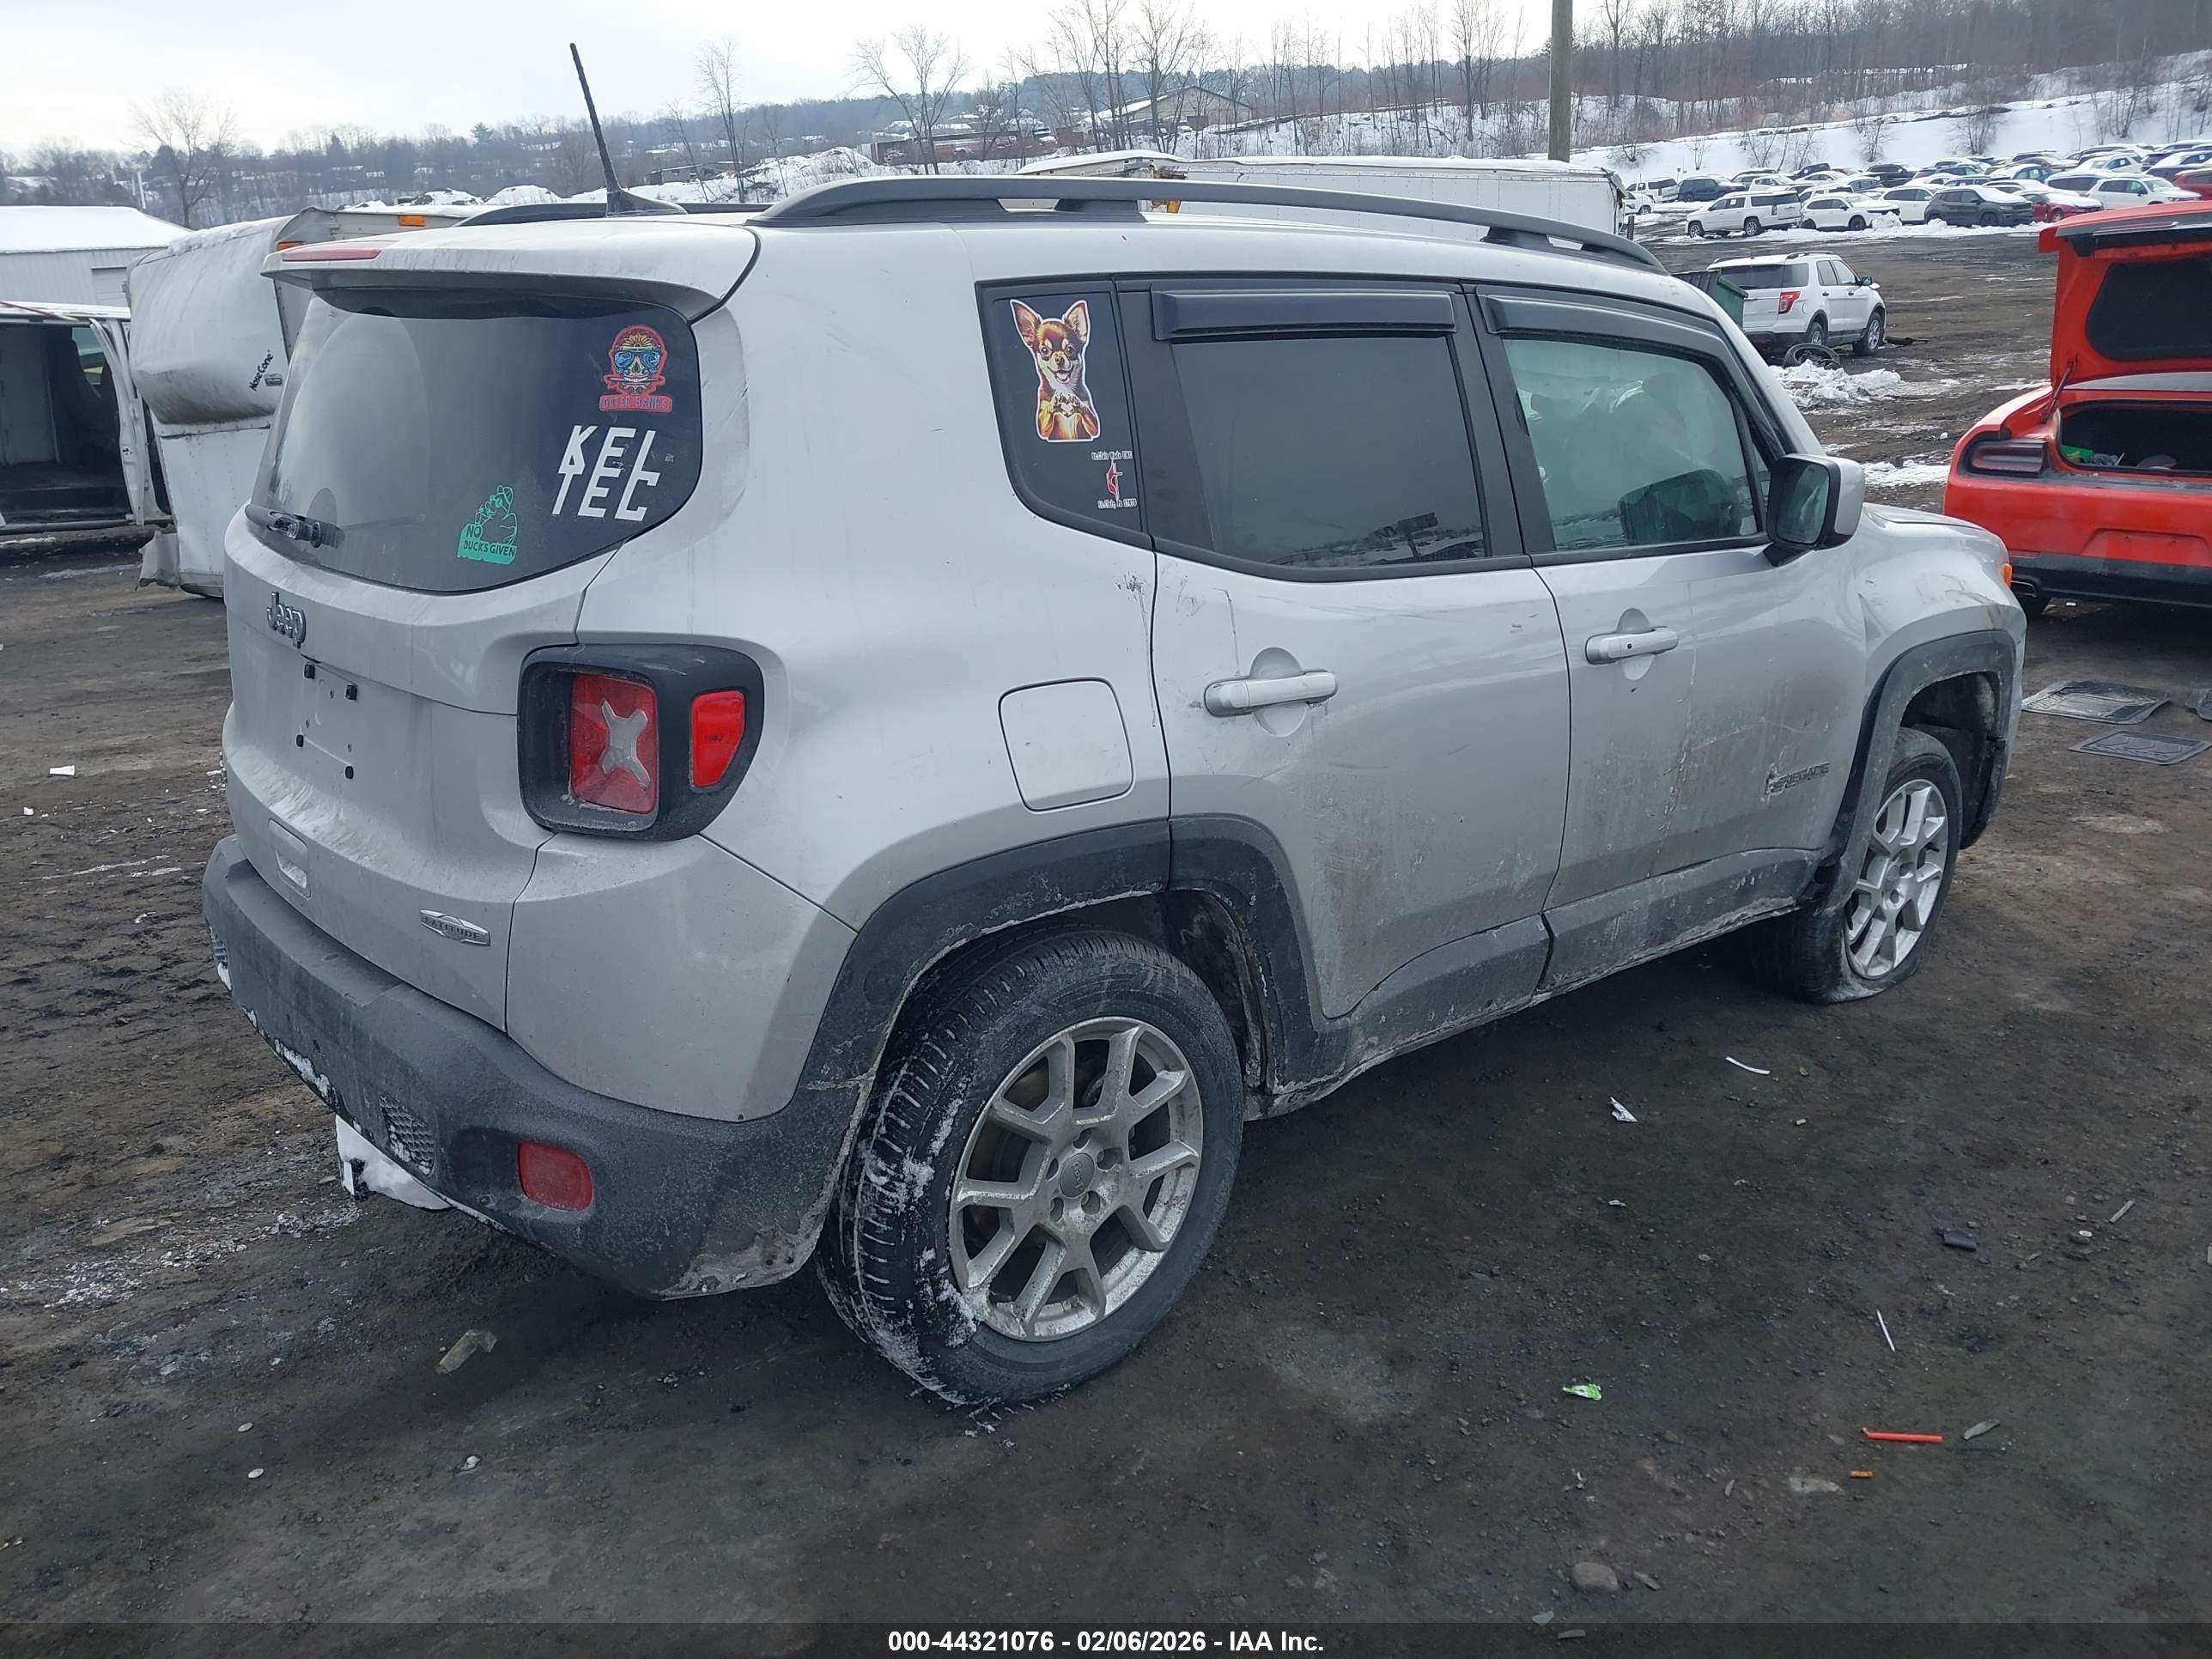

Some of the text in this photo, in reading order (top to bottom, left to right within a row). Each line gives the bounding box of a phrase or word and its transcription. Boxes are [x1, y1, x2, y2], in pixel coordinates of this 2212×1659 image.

[604, 397, 666, 410] OUTER BANKS
[557, 425, 656, 476] KEL
[551, 471, 659, 522] TEC
[465, 525, 482, 538] NO
[464, 540, 515, 557] DUCKS GIVEN
[266, 591, 307, 649] Jeep
[424, 915, 481, 939] LATITUDE
